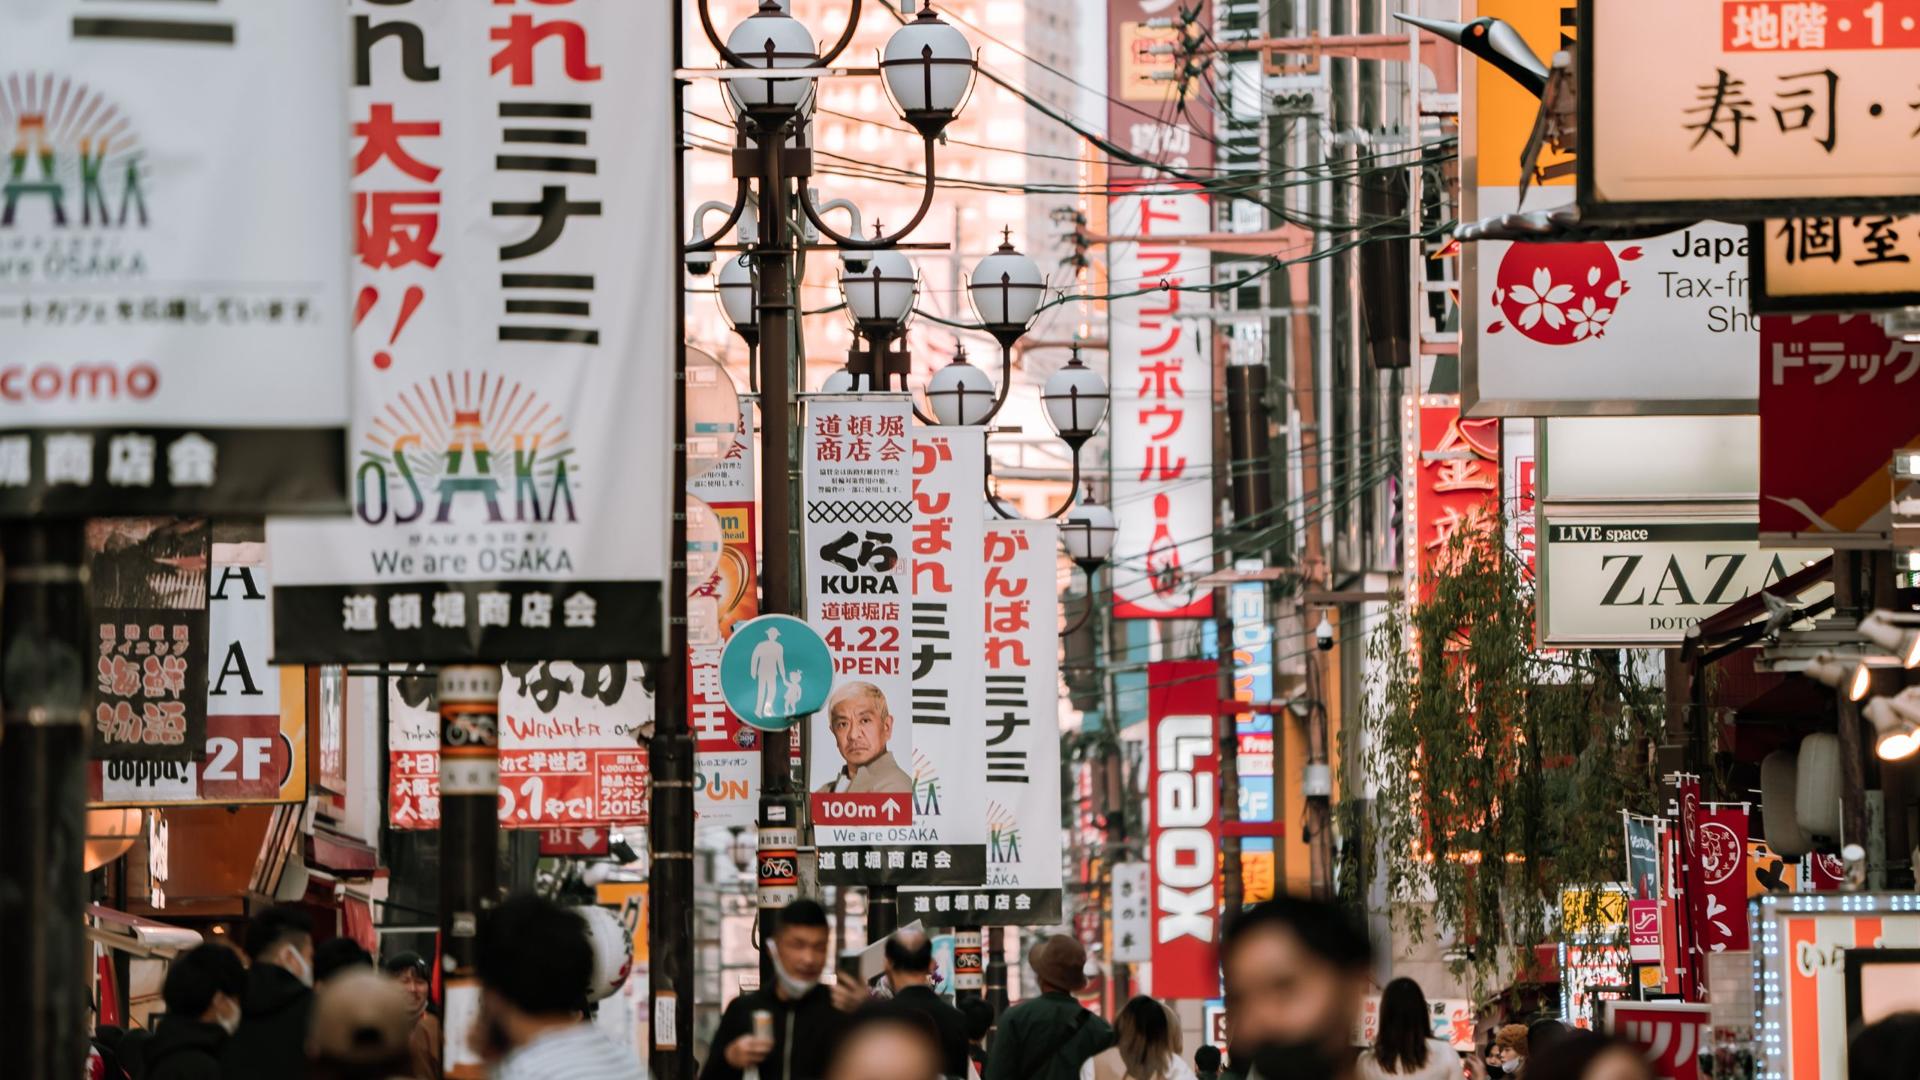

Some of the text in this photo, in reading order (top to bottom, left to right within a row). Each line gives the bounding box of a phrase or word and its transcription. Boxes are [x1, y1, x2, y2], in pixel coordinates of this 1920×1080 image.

[1683, 68, 1920, 157] 寿司・
[1136, 198, 1187, 482] ドラゴンボウル
[815, 414, 905, 438] 道頓堀
[816, 438, 906, 462] 商店会
[356, 411, 579, 525] OSAKA
[1559, 526, 1648, 543] LIVE space
[372, 548, 573, 575] We are OSAKA
[819, 529, 899, 574] くら
[821, 575, 899, 594] KURA
[342, 591, 597, 631] 道頓堀商店会
[821, 602, 900, 621] 道頓堀店
[825, 626, 900, 652] 4.22
[984, 530, 1030, 785] がんばれミナミ
[203, 737, 273, 780] 2F
[822, 801, 877, 819] 100m
[833, 828, 938, 842] We are OSAKA
[818, 850, 952, 870] 道頓堀商店会
[914, 893, 1031, 912] 道頓堀商店会
[1642, 936, 1659, 944] 入口
